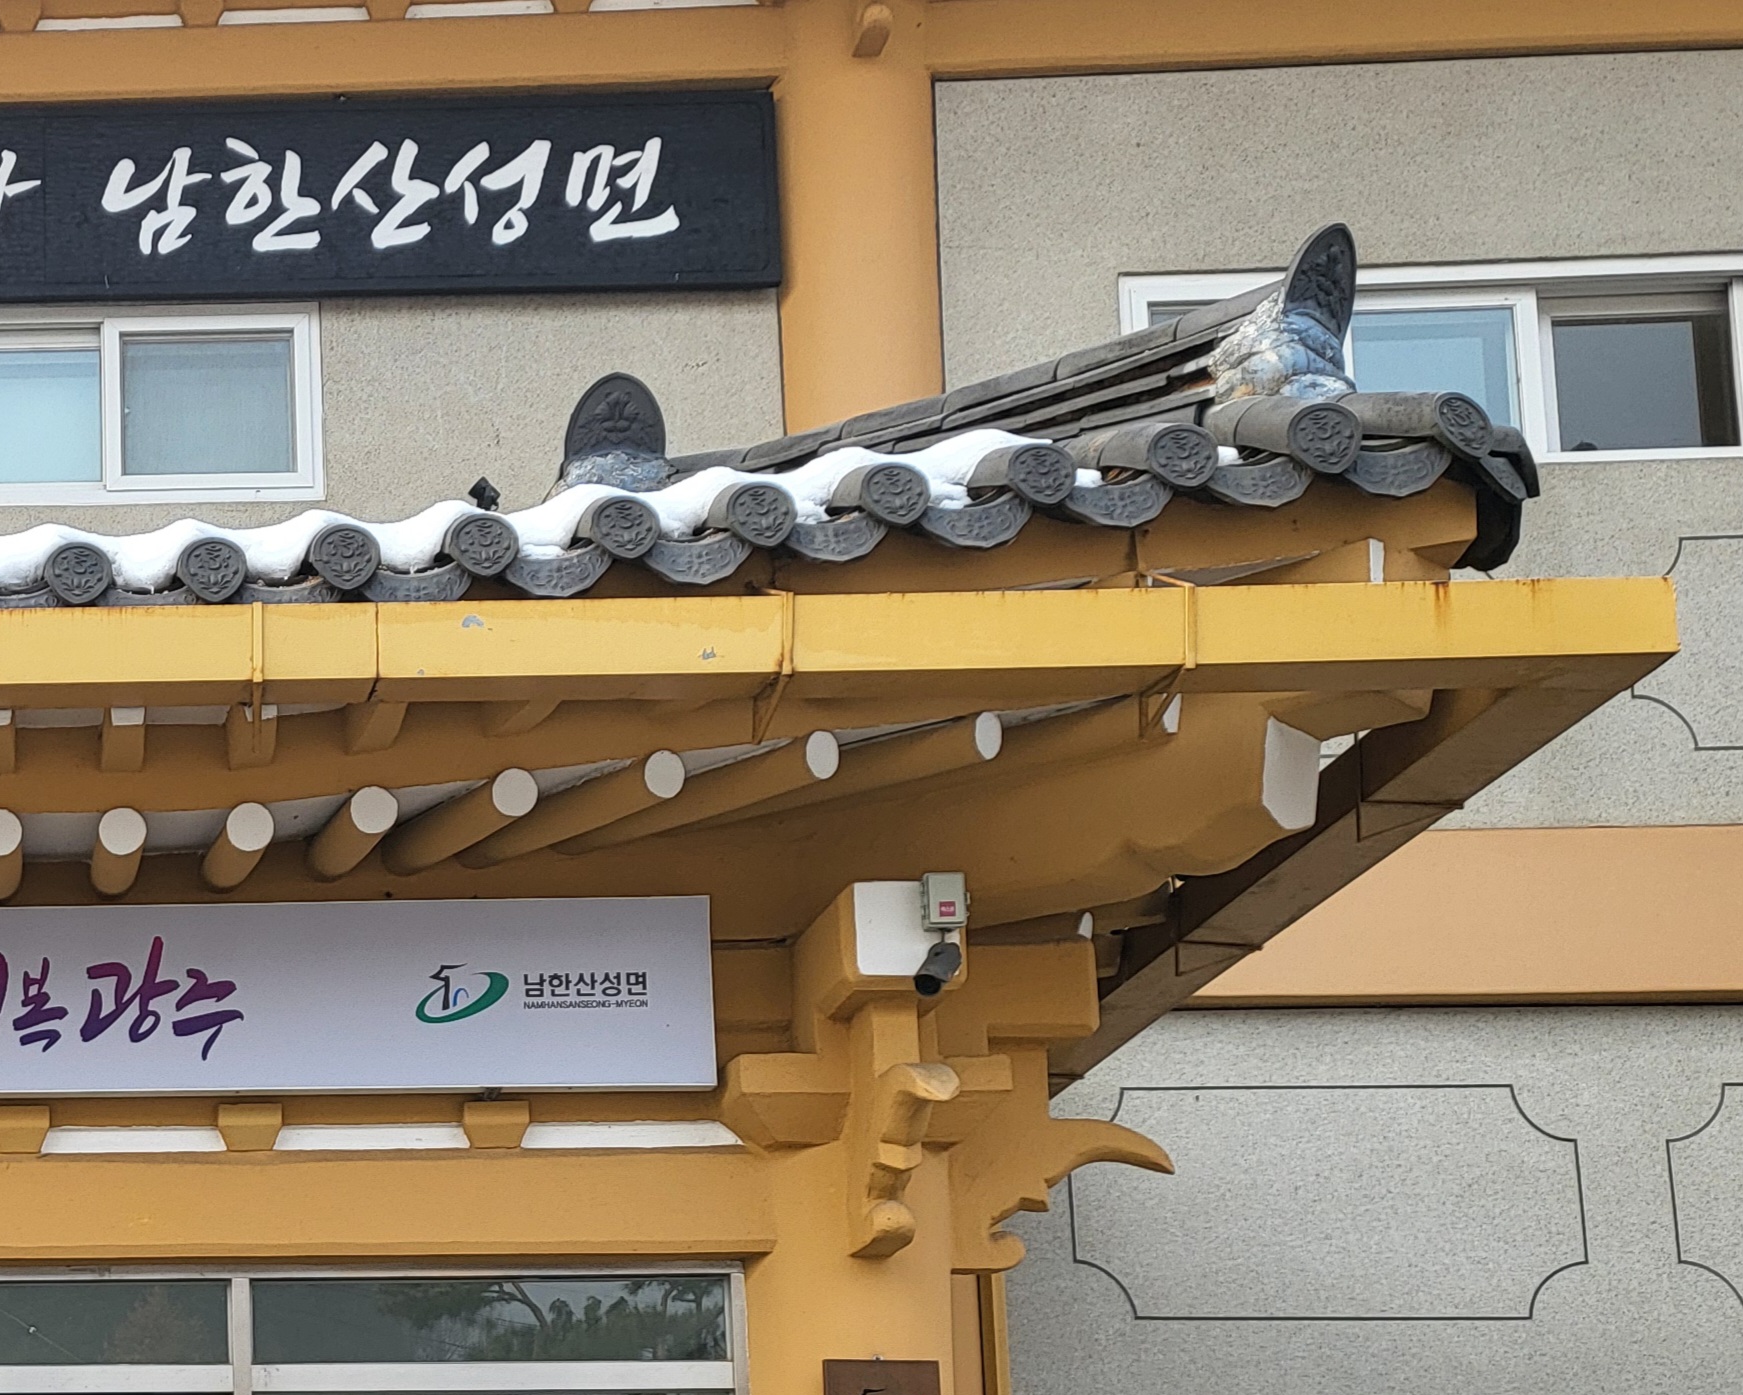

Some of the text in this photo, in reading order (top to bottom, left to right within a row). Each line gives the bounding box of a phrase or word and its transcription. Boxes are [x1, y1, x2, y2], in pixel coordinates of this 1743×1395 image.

[102, 138, 681, 256] 남한산성면
[523, 972, 649, 999] 남한산성면
[523, 1000, 649, 1011] NAMHANSANSEONG-MYEON
